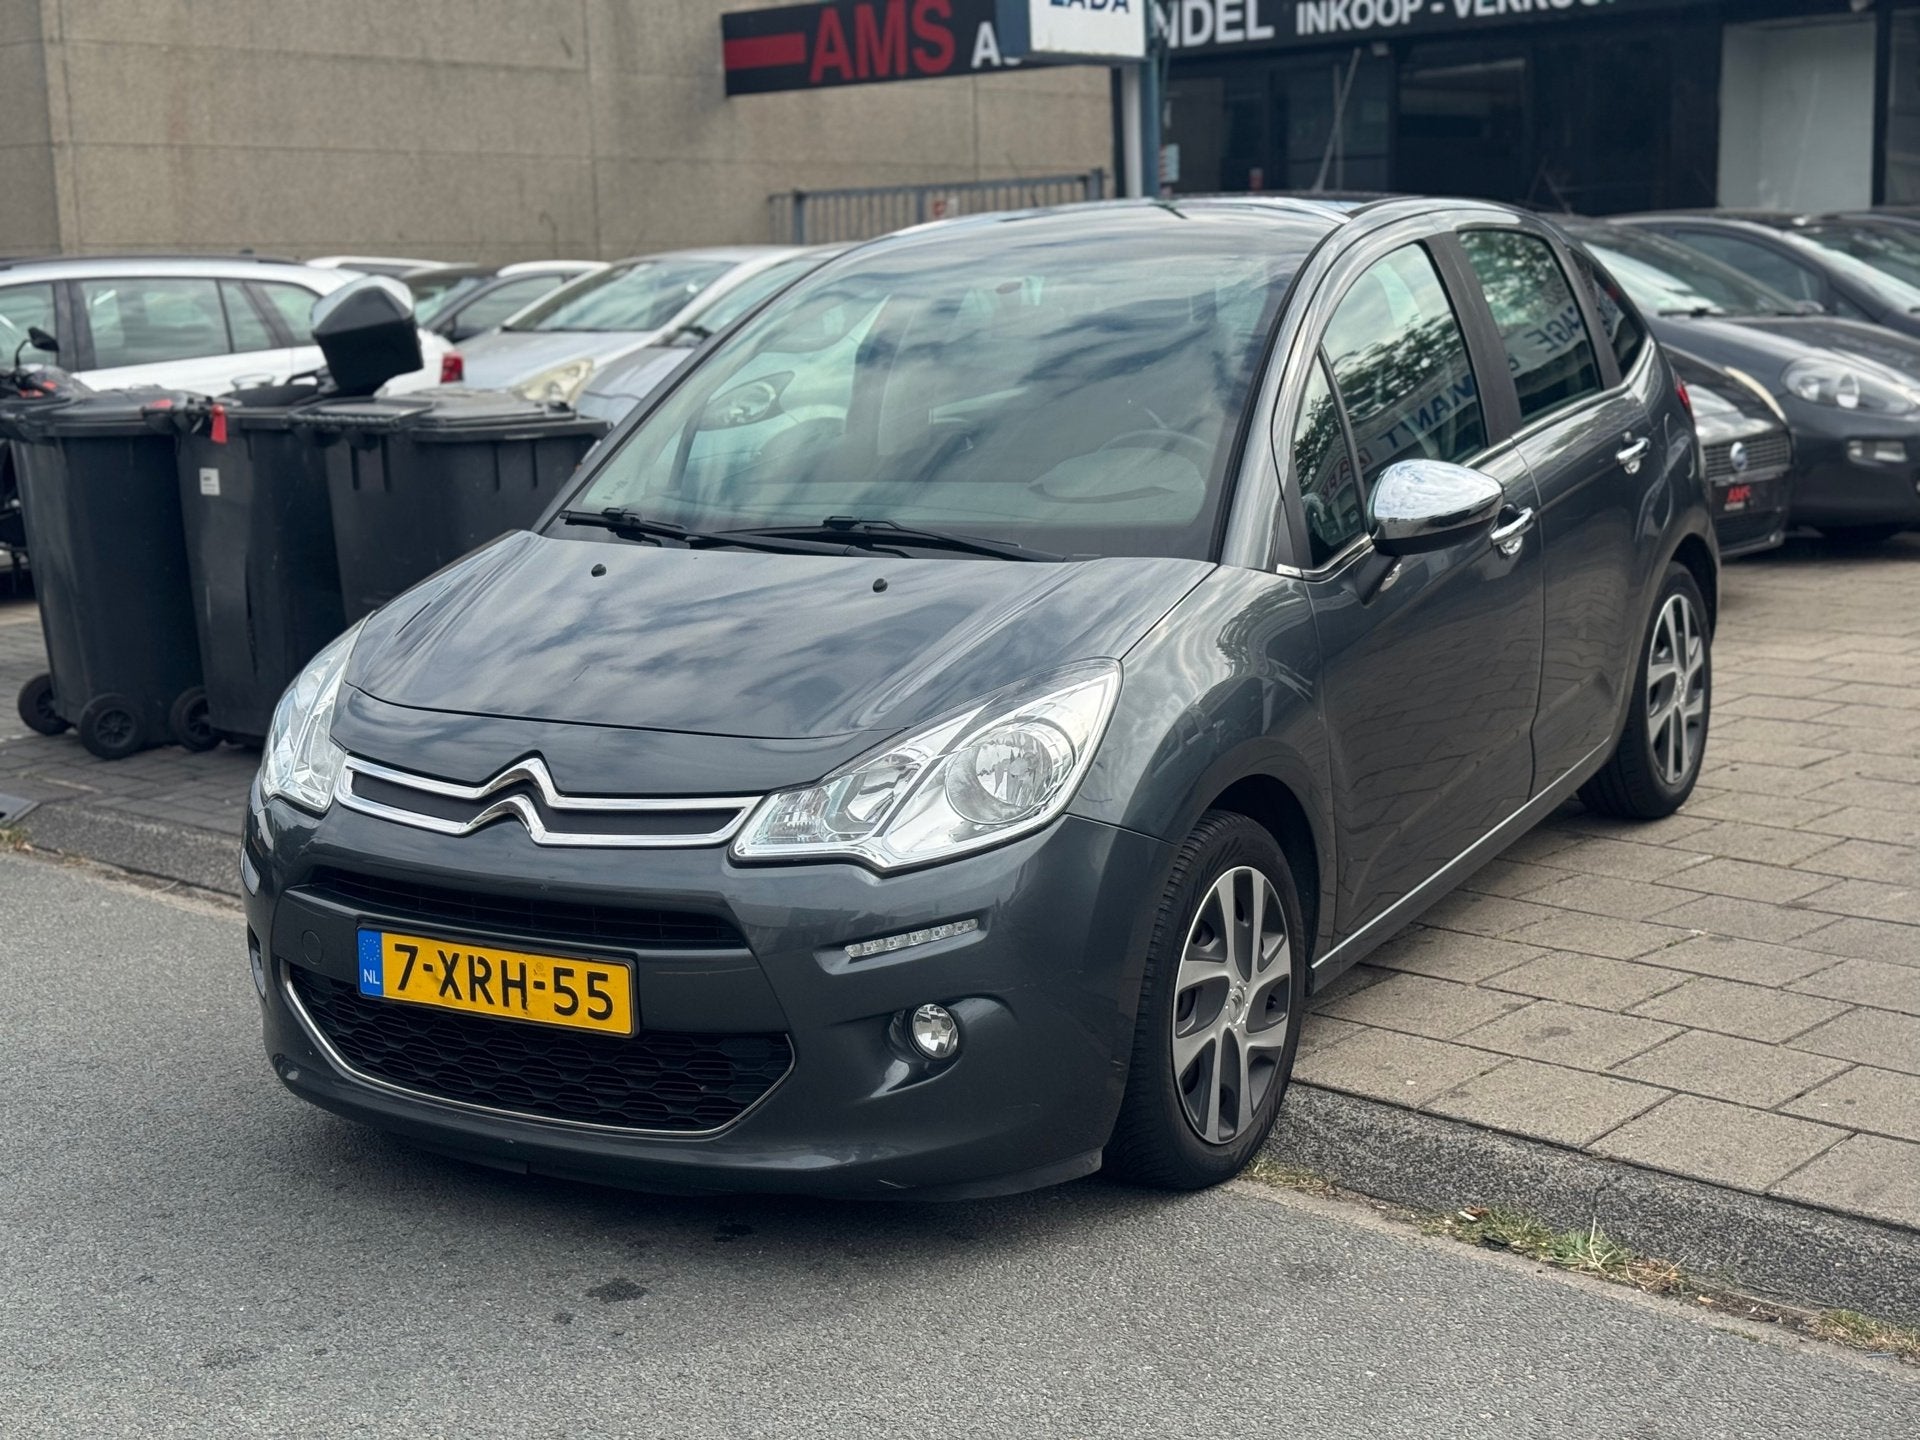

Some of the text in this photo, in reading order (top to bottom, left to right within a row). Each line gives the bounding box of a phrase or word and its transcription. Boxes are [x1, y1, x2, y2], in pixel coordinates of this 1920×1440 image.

[811, 1, 956, 81] AMS
[1152, 0, 1275, 48] NDEL
[1296, 0, 1422, 35] INKOOP
[363, 969, 380, 985] NL
[394, 943, 614, 1021] 7-XRH-55
